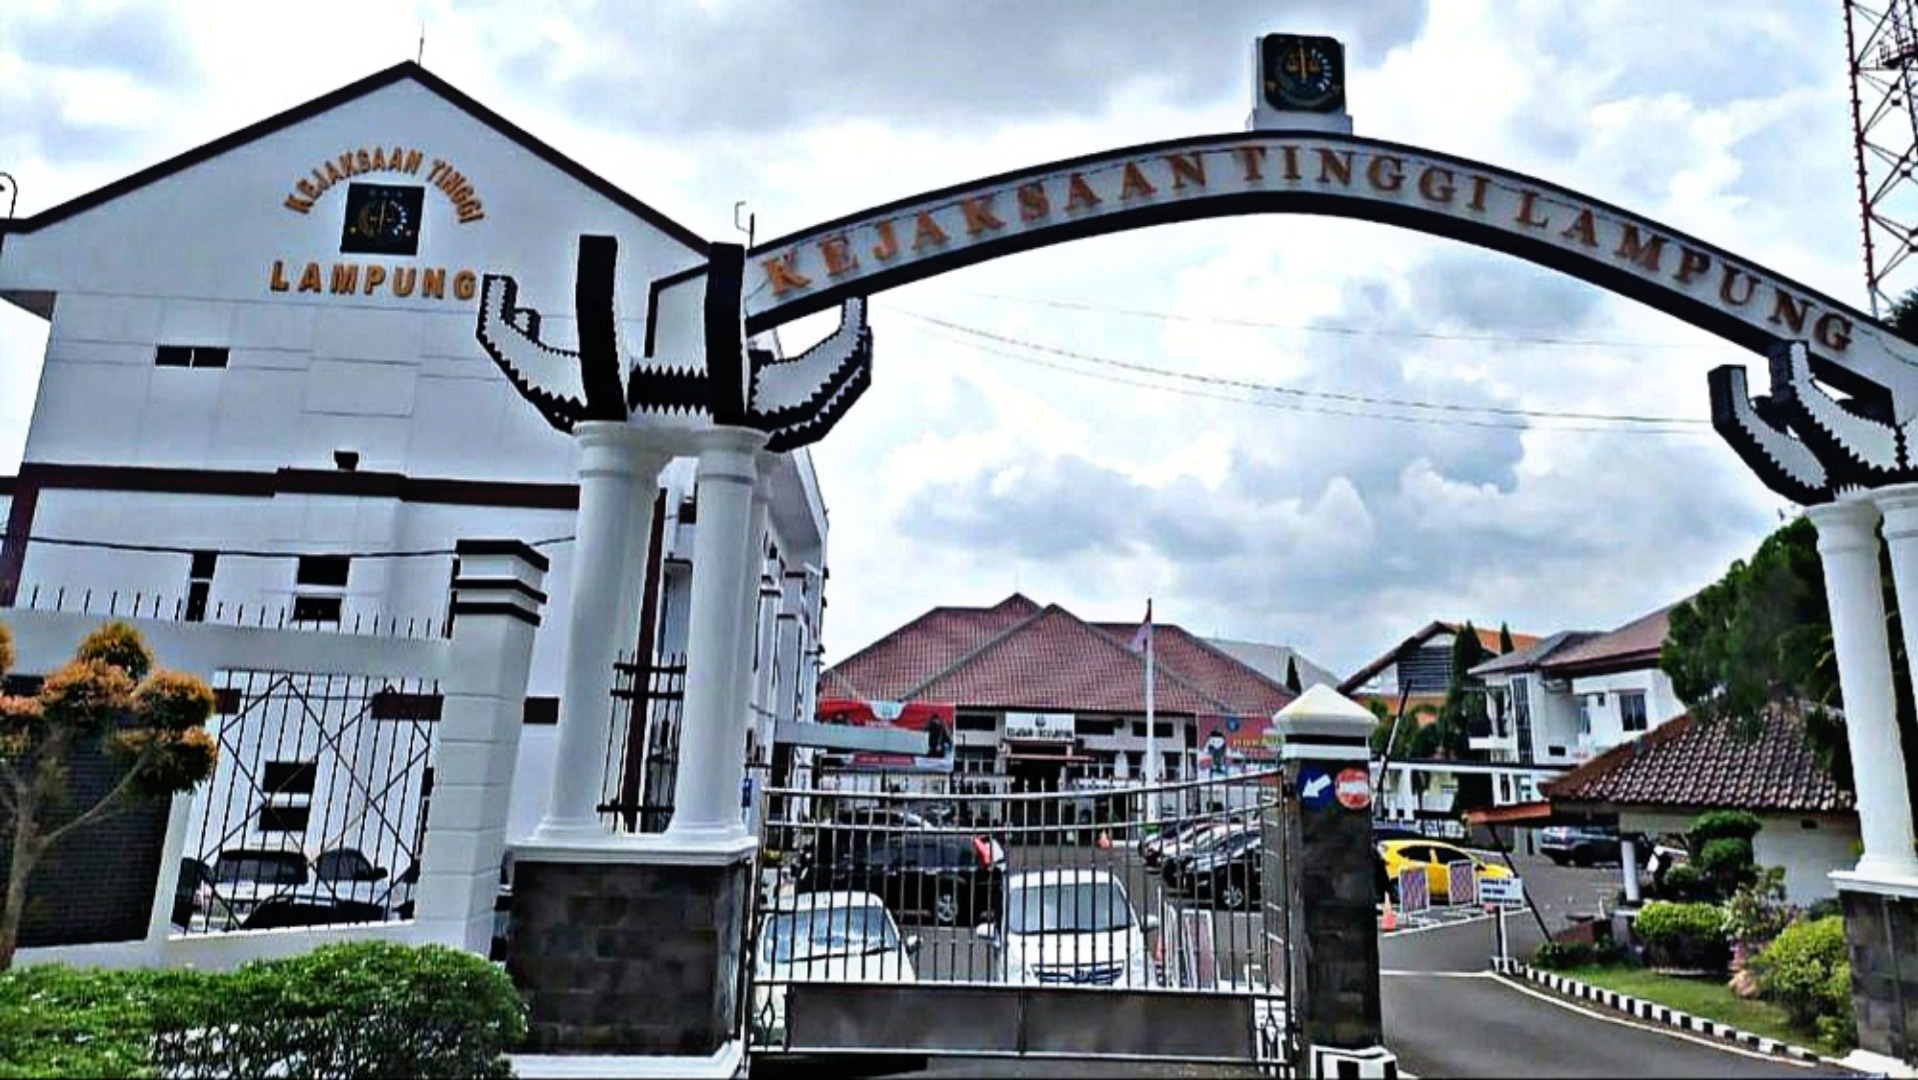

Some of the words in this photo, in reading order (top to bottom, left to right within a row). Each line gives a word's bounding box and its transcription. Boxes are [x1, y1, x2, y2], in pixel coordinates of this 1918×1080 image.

[284, 146, 423, 214] KEJAKSAAN
[426, 159, 485, 224] TINGGI
[270, 260, 476, 300] LAMPUNG
[763, 147, 1207, 297] KEJAKSAAN
[1232, 145, 1490, 212] TINGGI
[1517, 187, 1855, 353] LAMPUNG
